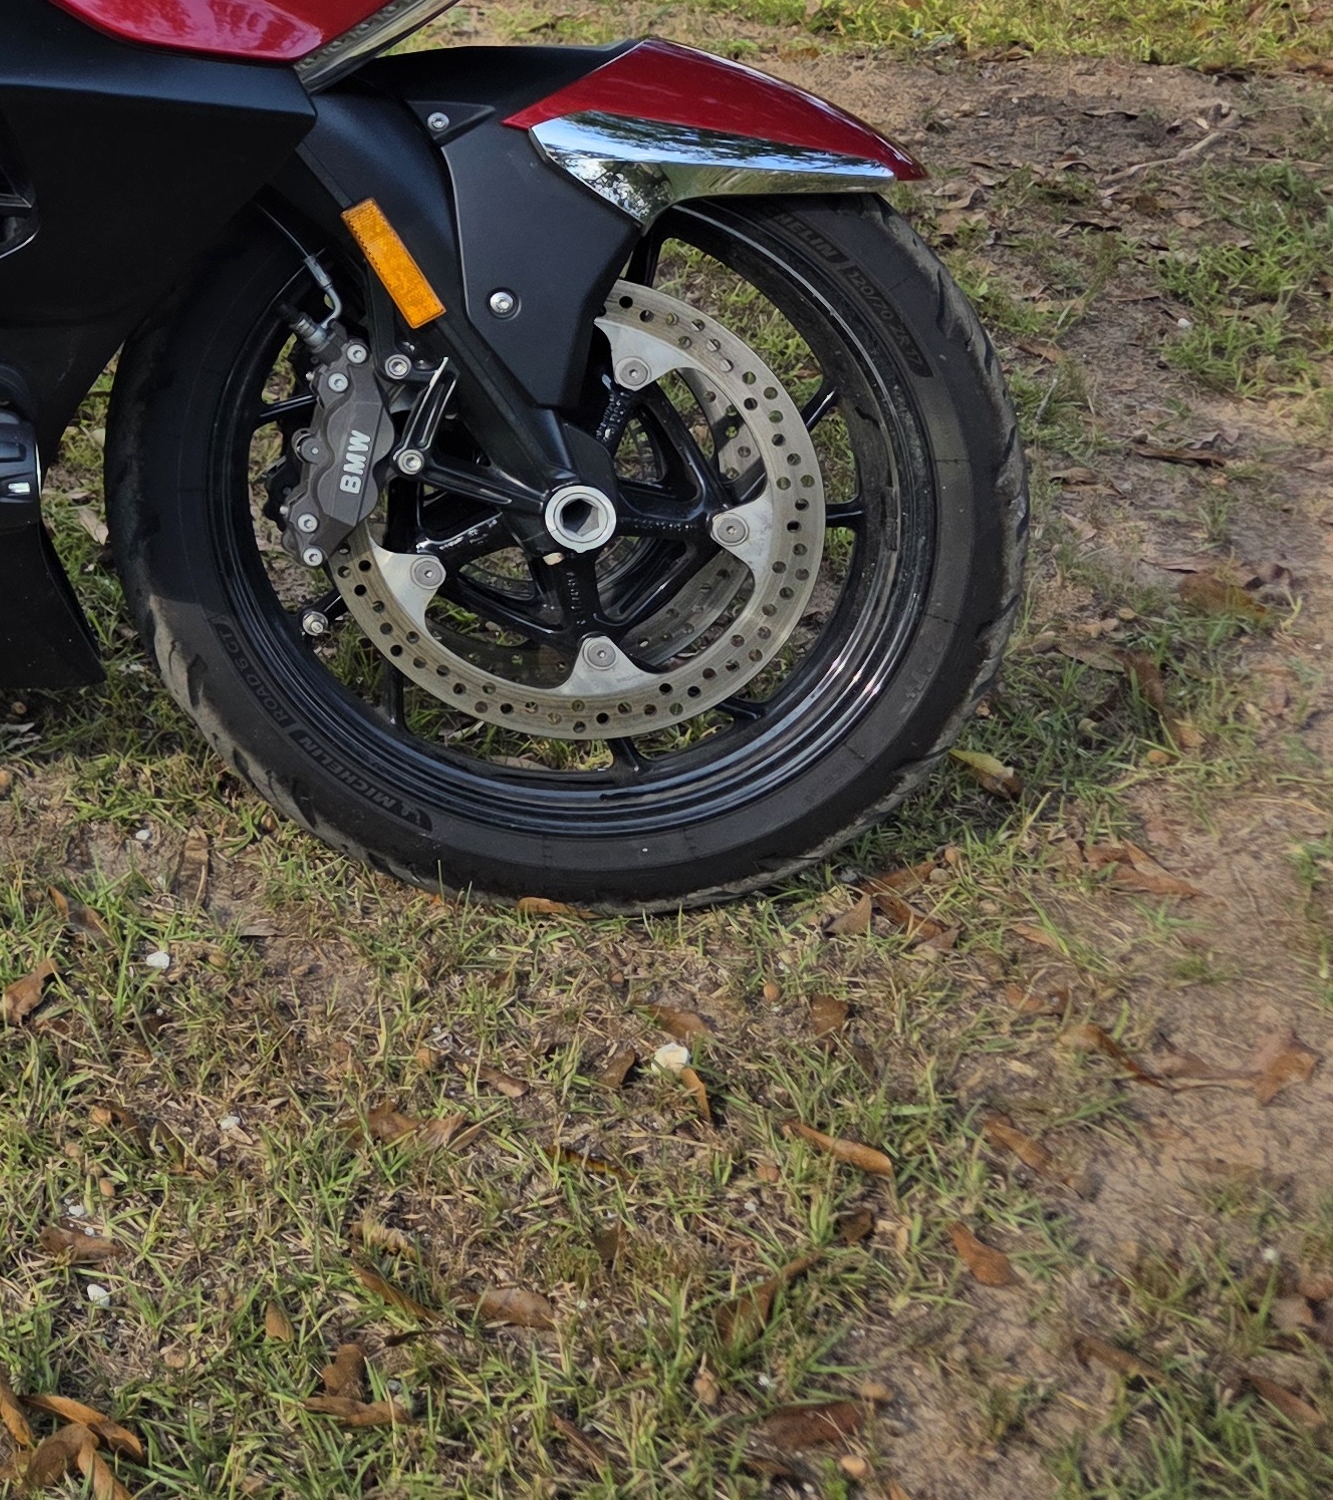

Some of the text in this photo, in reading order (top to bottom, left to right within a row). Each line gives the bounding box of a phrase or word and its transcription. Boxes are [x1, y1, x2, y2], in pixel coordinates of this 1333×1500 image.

[773, 213, 837, 258] HELIN
[339, 429, 371, 494] BMW
[247, 674, 290, 723] ROAD
[299, 736, 397, 808] MICHELIN
